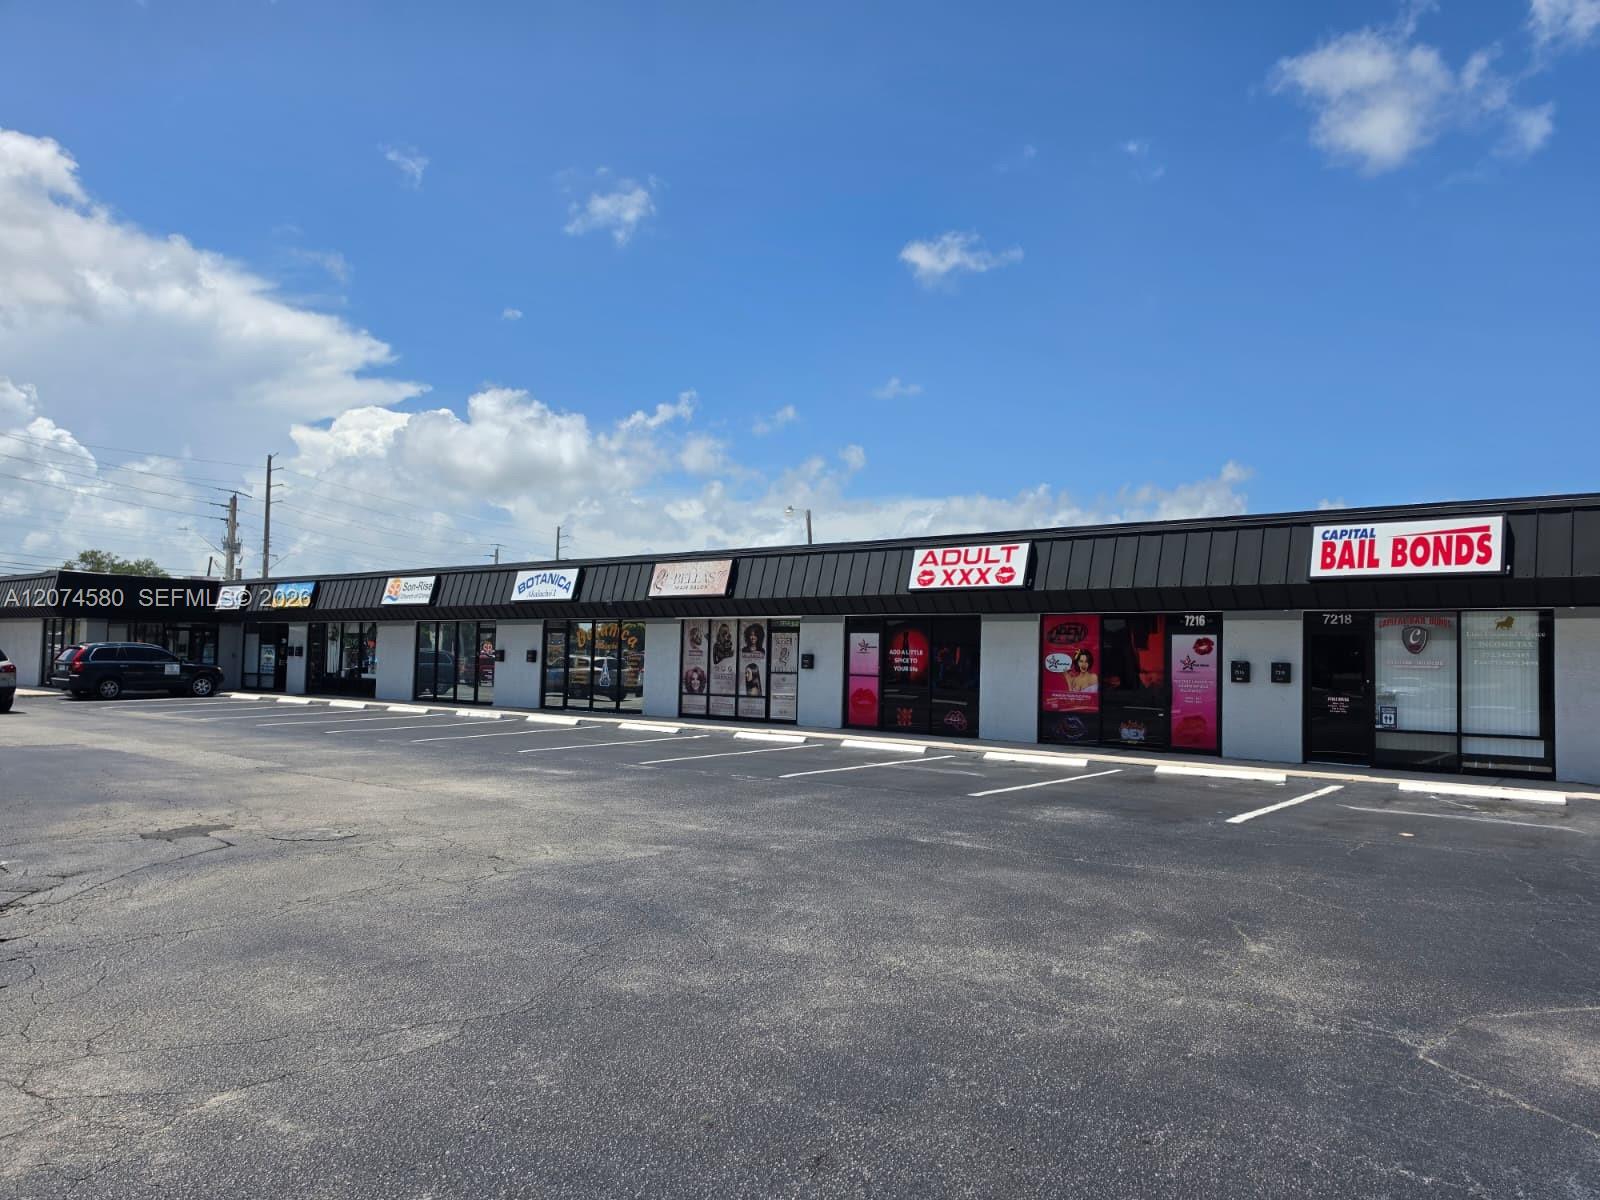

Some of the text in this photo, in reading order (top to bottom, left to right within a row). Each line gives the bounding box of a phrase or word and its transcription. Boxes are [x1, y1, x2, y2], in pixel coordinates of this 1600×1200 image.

[1321, 527, 1376, 540] CAPITAL
[919, 545, 1019, 567] ADULT
[1320, 532, 1493, 570] BAIL BONDS
[517, 572, 572, 595] BOTANICA
[940, 567, 992, 586] XXX
[1184, 614, 1206, 626] 7216
[1322, 614, 1353, 625] 7218
